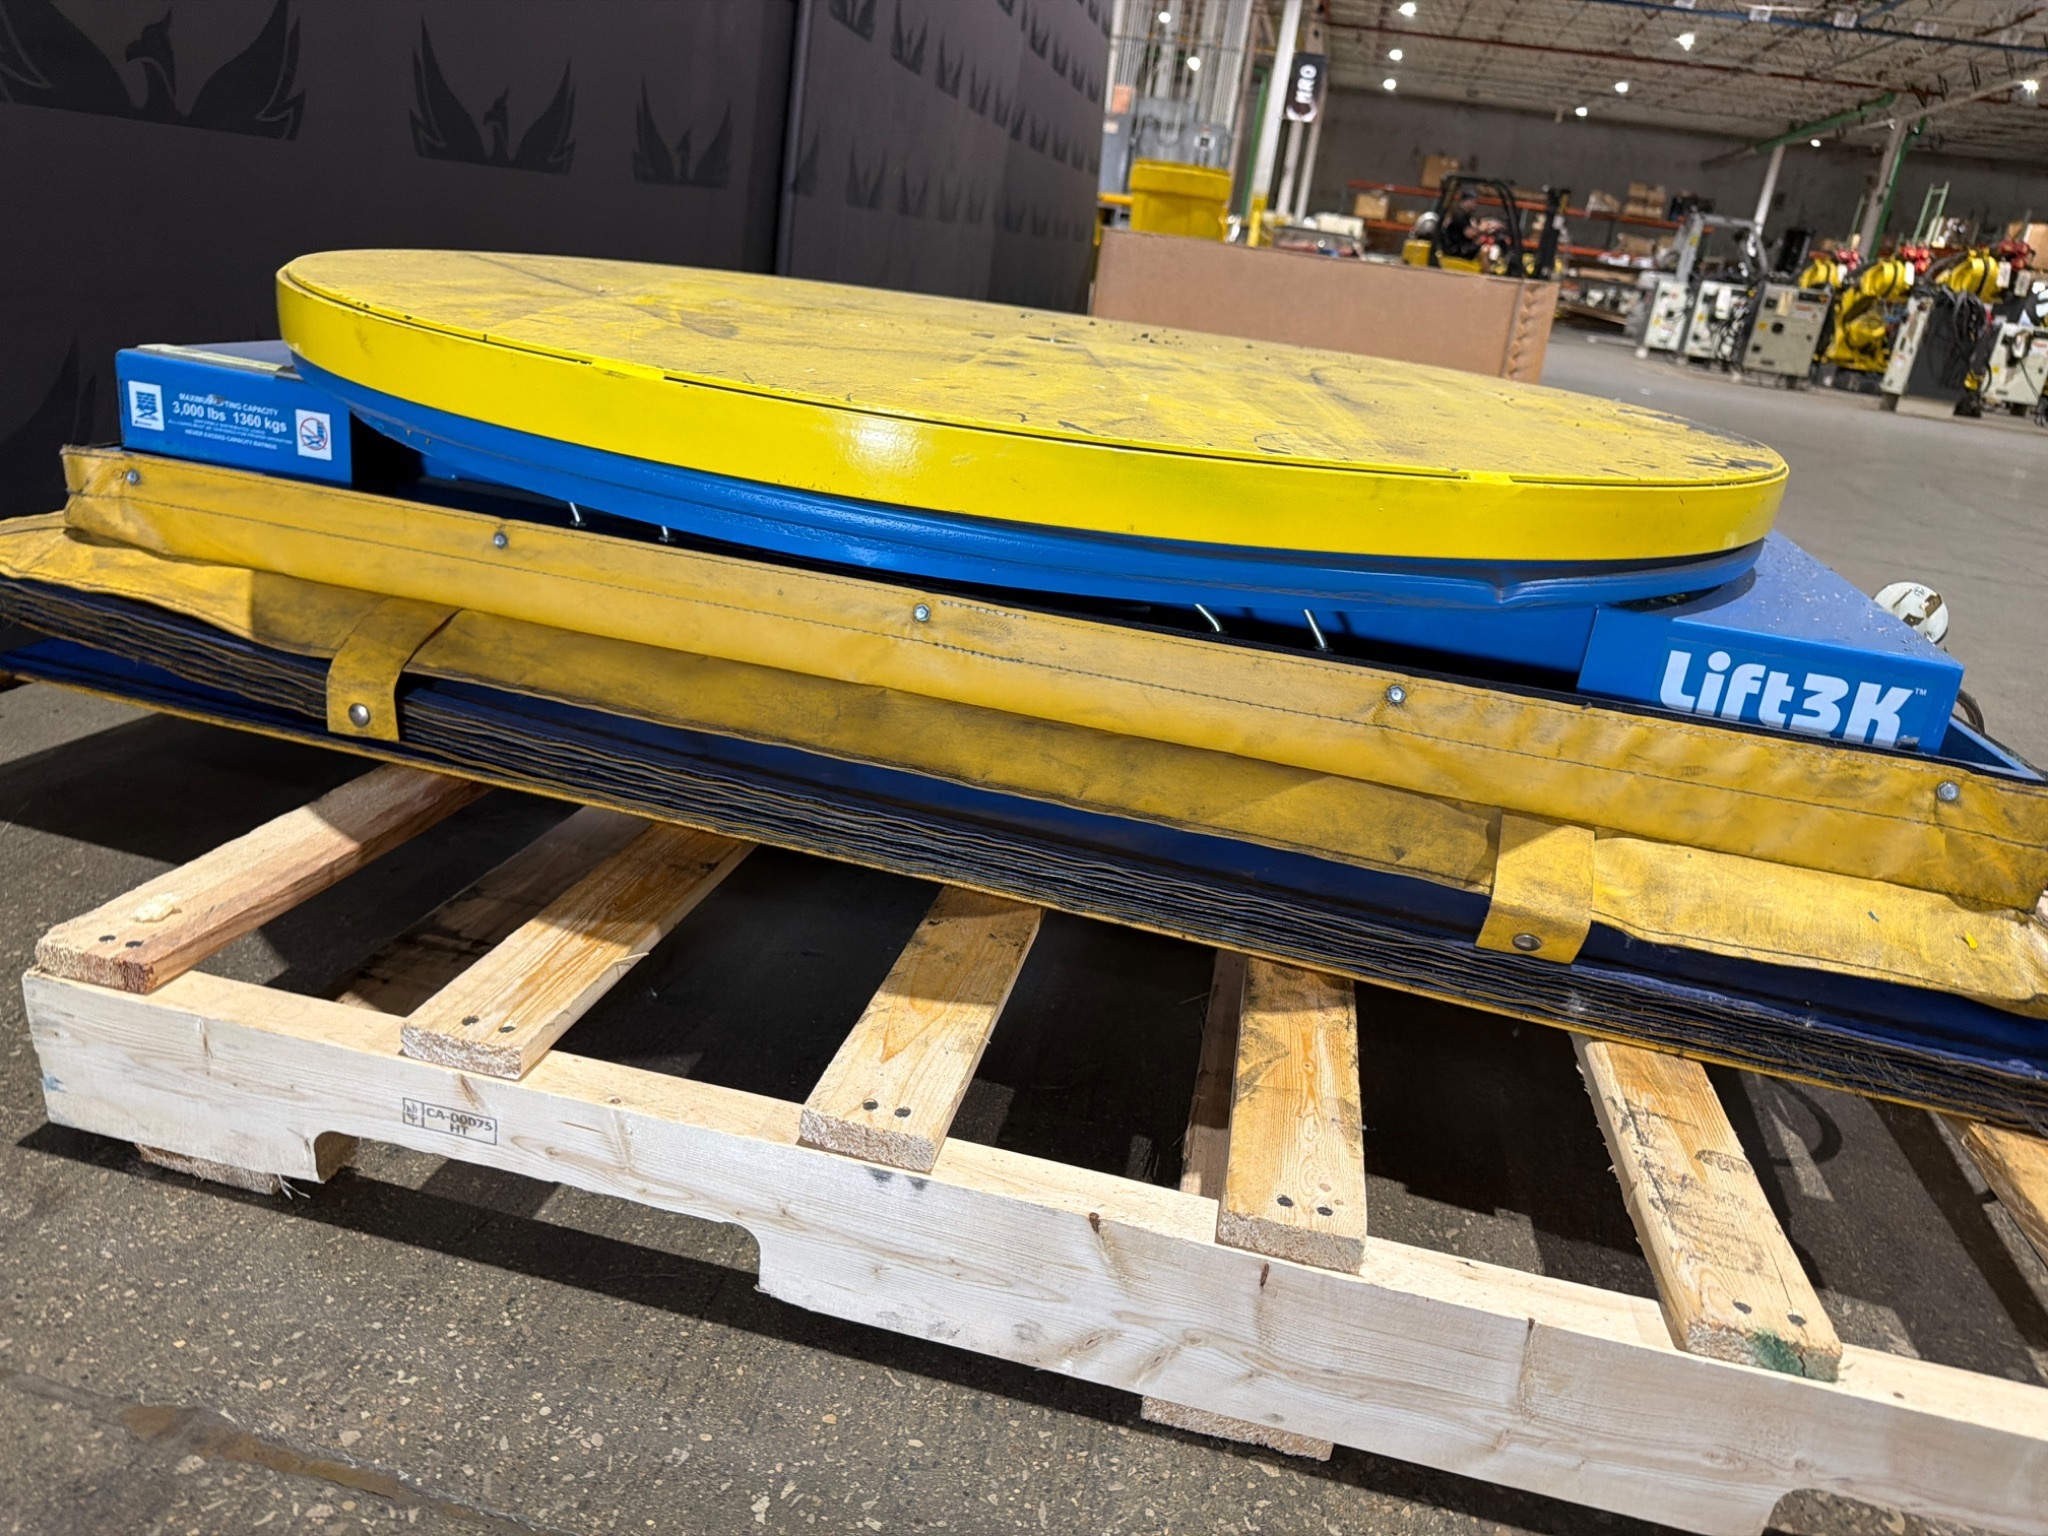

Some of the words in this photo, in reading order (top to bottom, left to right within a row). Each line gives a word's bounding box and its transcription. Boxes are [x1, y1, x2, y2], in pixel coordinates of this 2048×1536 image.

[242, 403, 279, 416] CAPACITY
[172, 400, 205, 417] 3,000
[207, 406, 227, 422] lbs
[233, 411, 261, 428] 1360
[264, 417, 288, 434] kgs
[449, 1122, 469, 1136] HT
